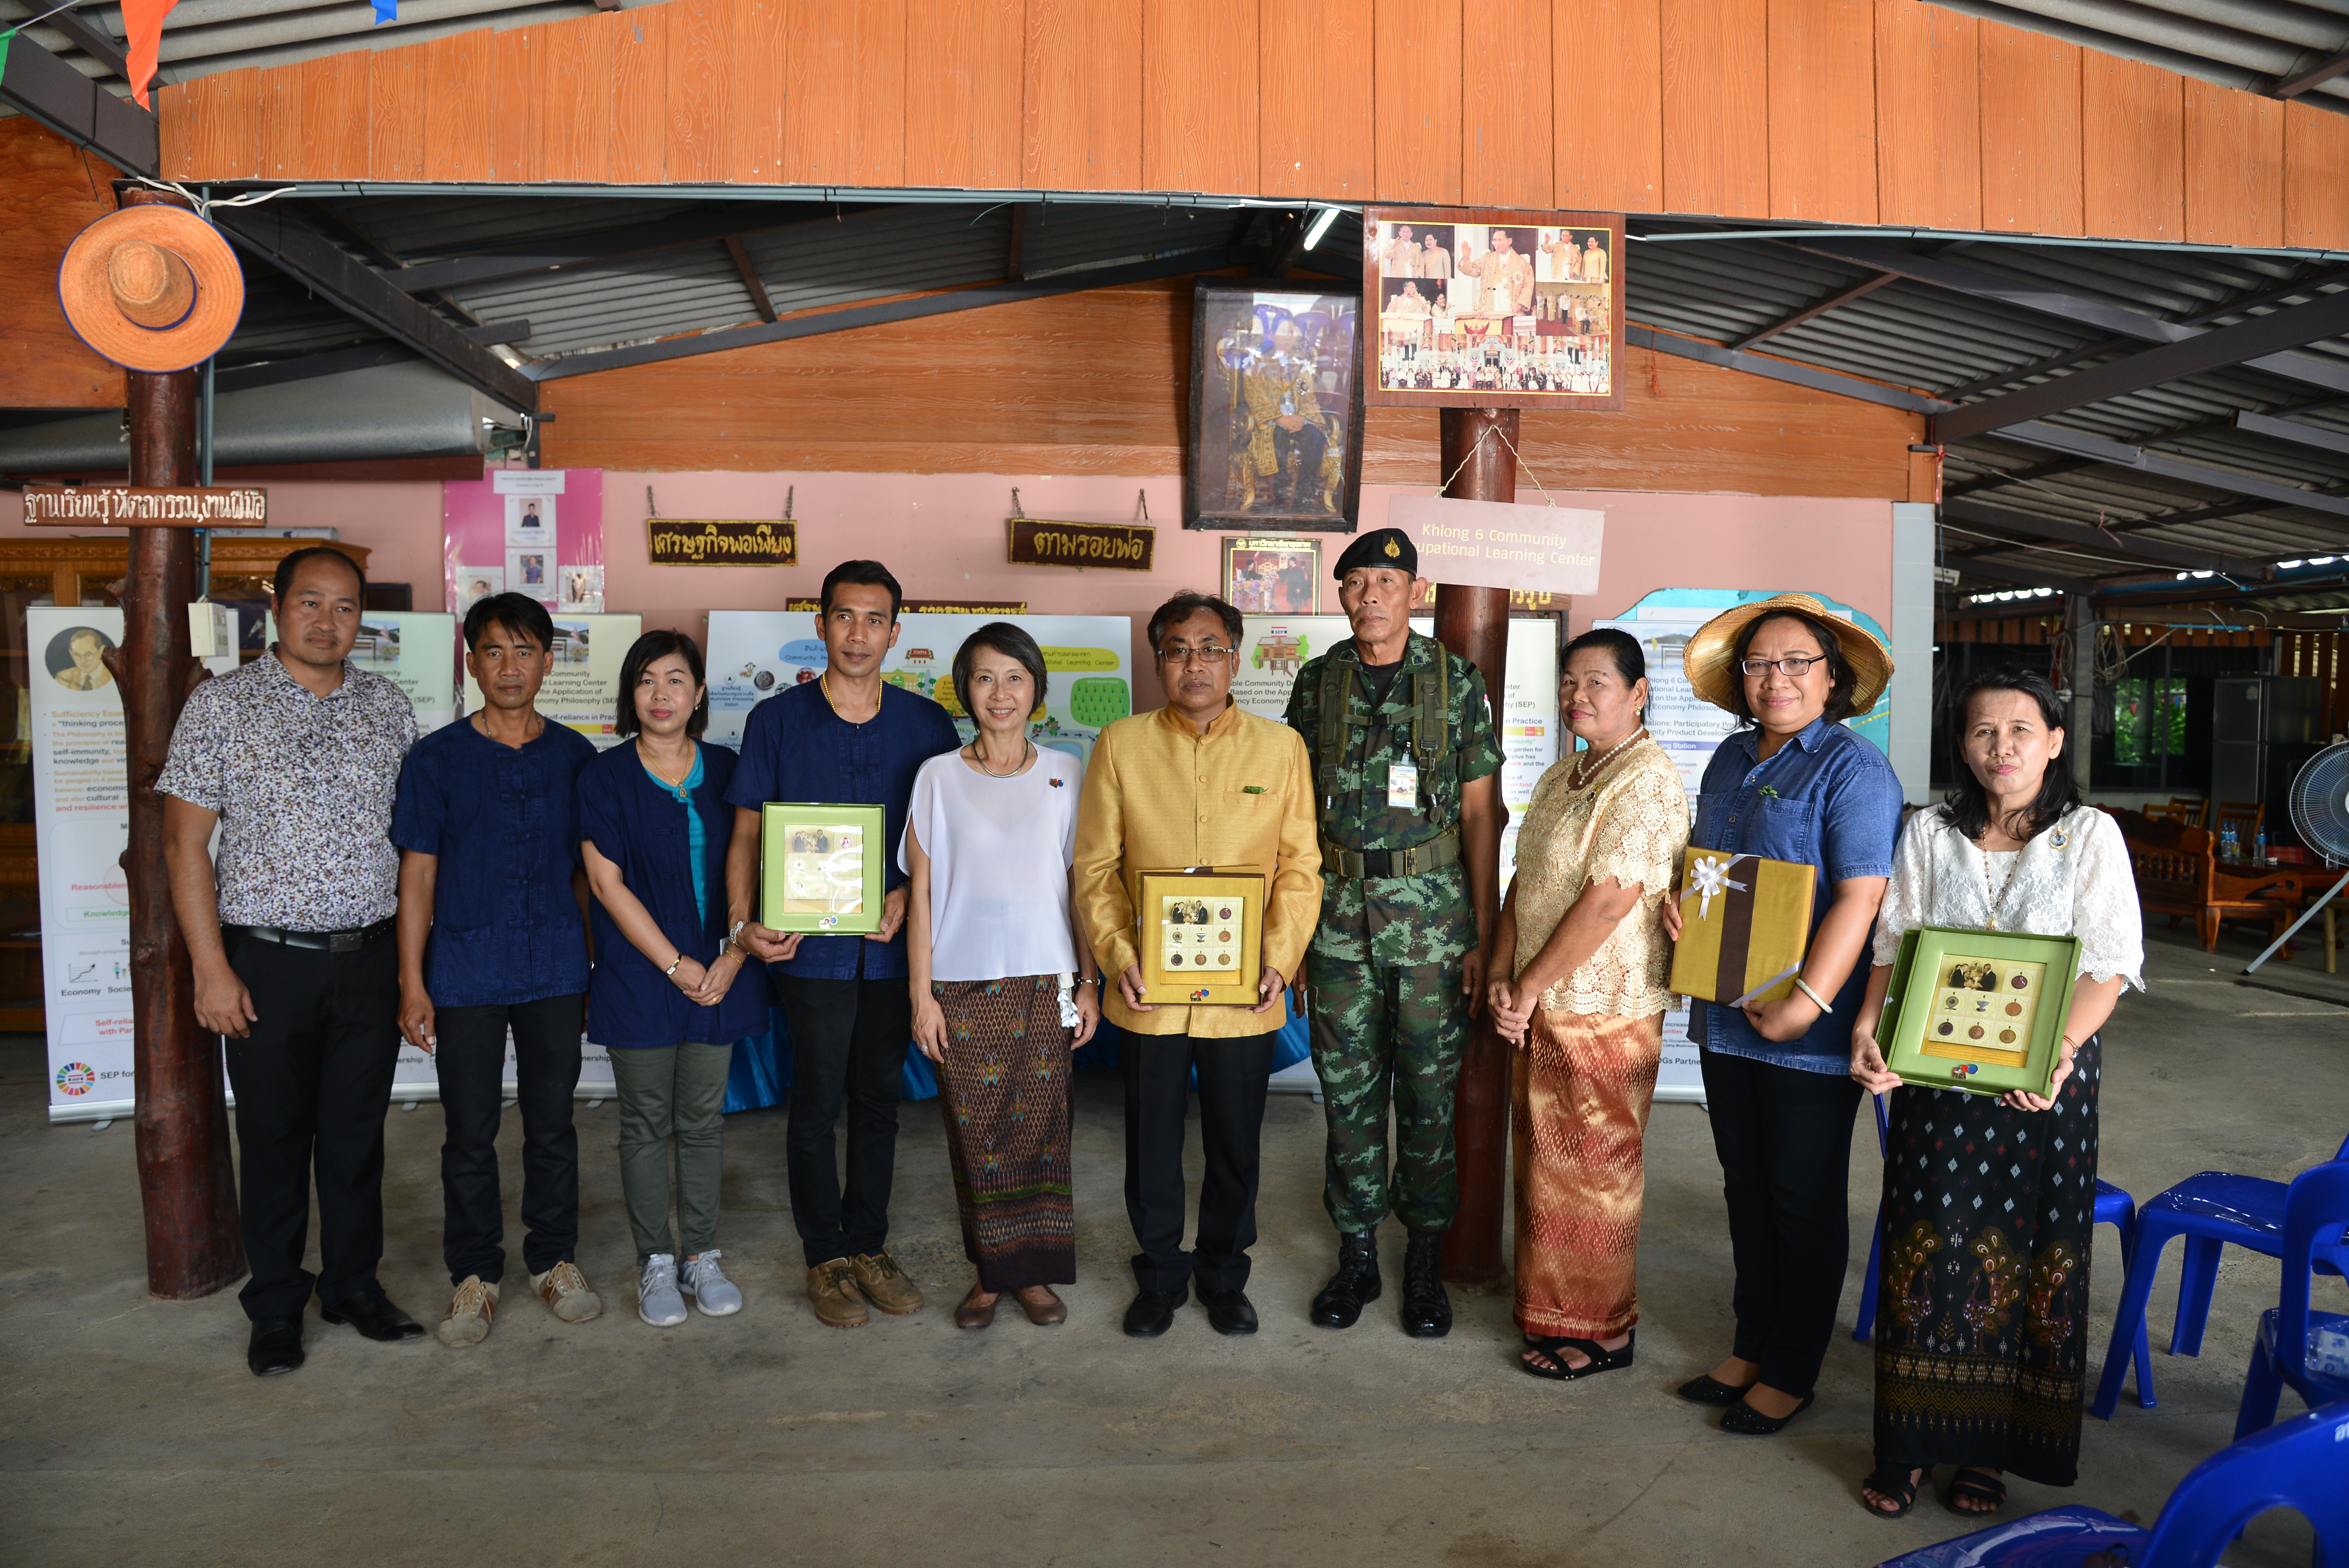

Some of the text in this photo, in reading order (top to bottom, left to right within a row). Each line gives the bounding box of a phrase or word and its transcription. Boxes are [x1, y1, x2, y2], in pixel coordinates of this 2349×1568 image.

[25, 488, 111, 524] ฐานเรียนรู้
[654, 524, 791, 560] เศรษฐกิจพอเพียง
[1034, 529, 1144, 560] ตามรอยพ่อ
[1422, 524, 1567, 549] Khlong 6 Community
[1412, 542, 1595, 566] upational Learning Center
[1674, 720, 1720, 729] Participatory
[100, 1071, 119, 1079] SEP
